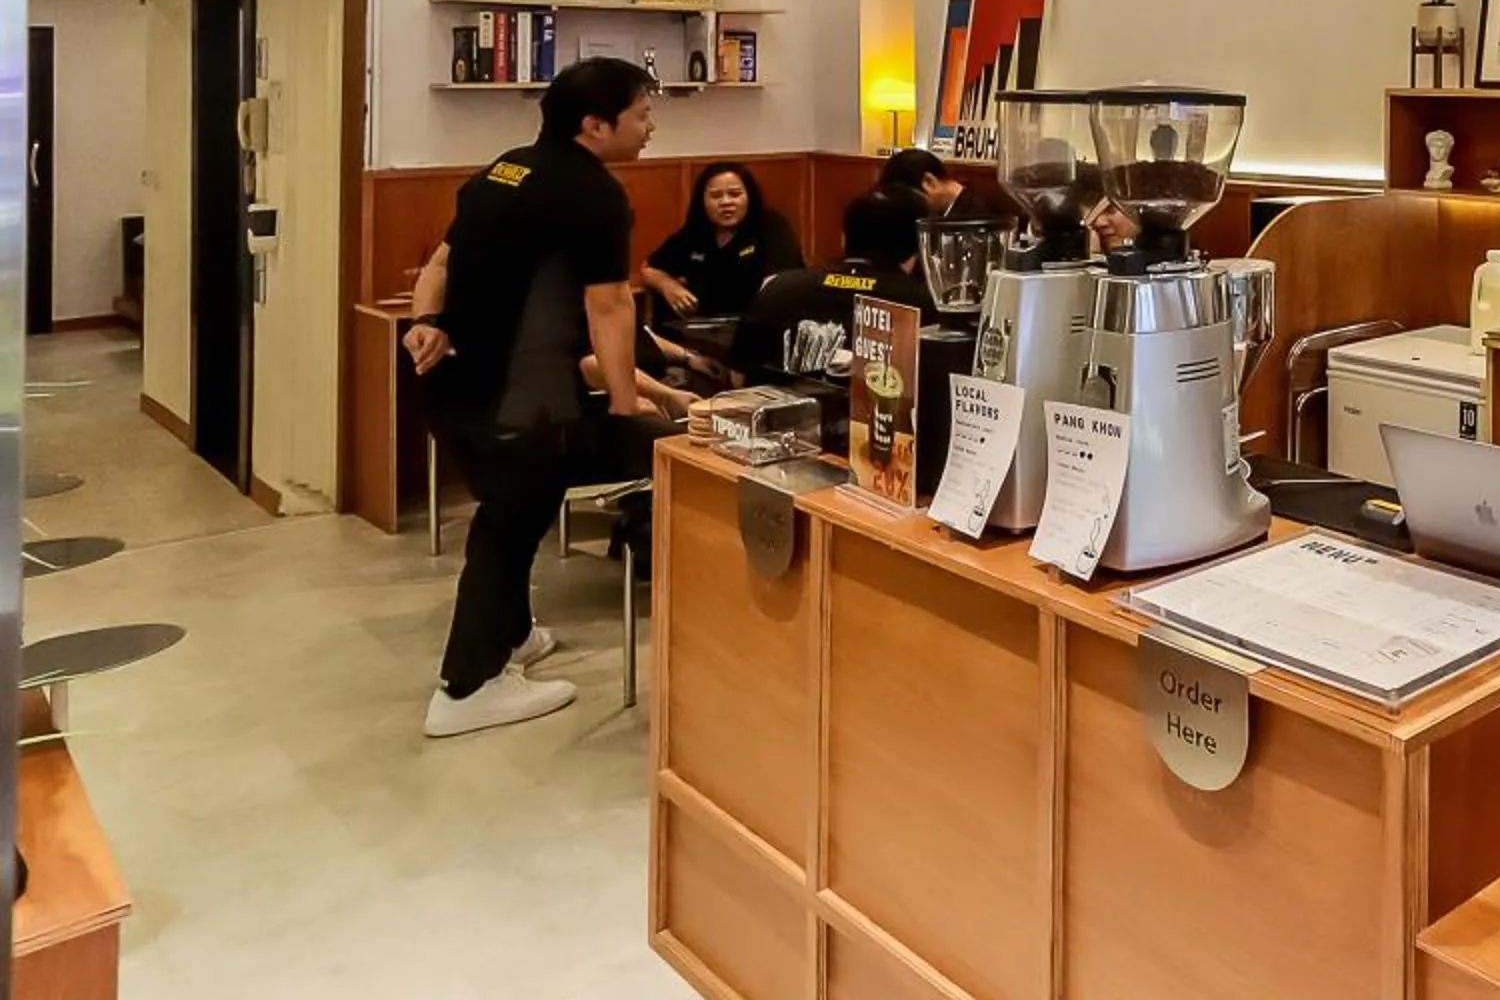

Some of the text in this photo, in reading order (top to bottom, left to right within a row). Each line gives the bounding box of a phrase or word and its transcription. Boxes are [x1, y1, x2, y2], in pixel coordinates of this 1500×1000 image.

[955, 385, 988, 402] LOCAL
[955, 399, 999, 421] FLAVORS
[1054, 412, 1085, 430] PANG
[1462, 408, 1475, 427] 10
[1300, 541, 1364, 564] MENU
[1160, 669, 1223, 714] Order
[1167, 711, 1217, 755] Here
